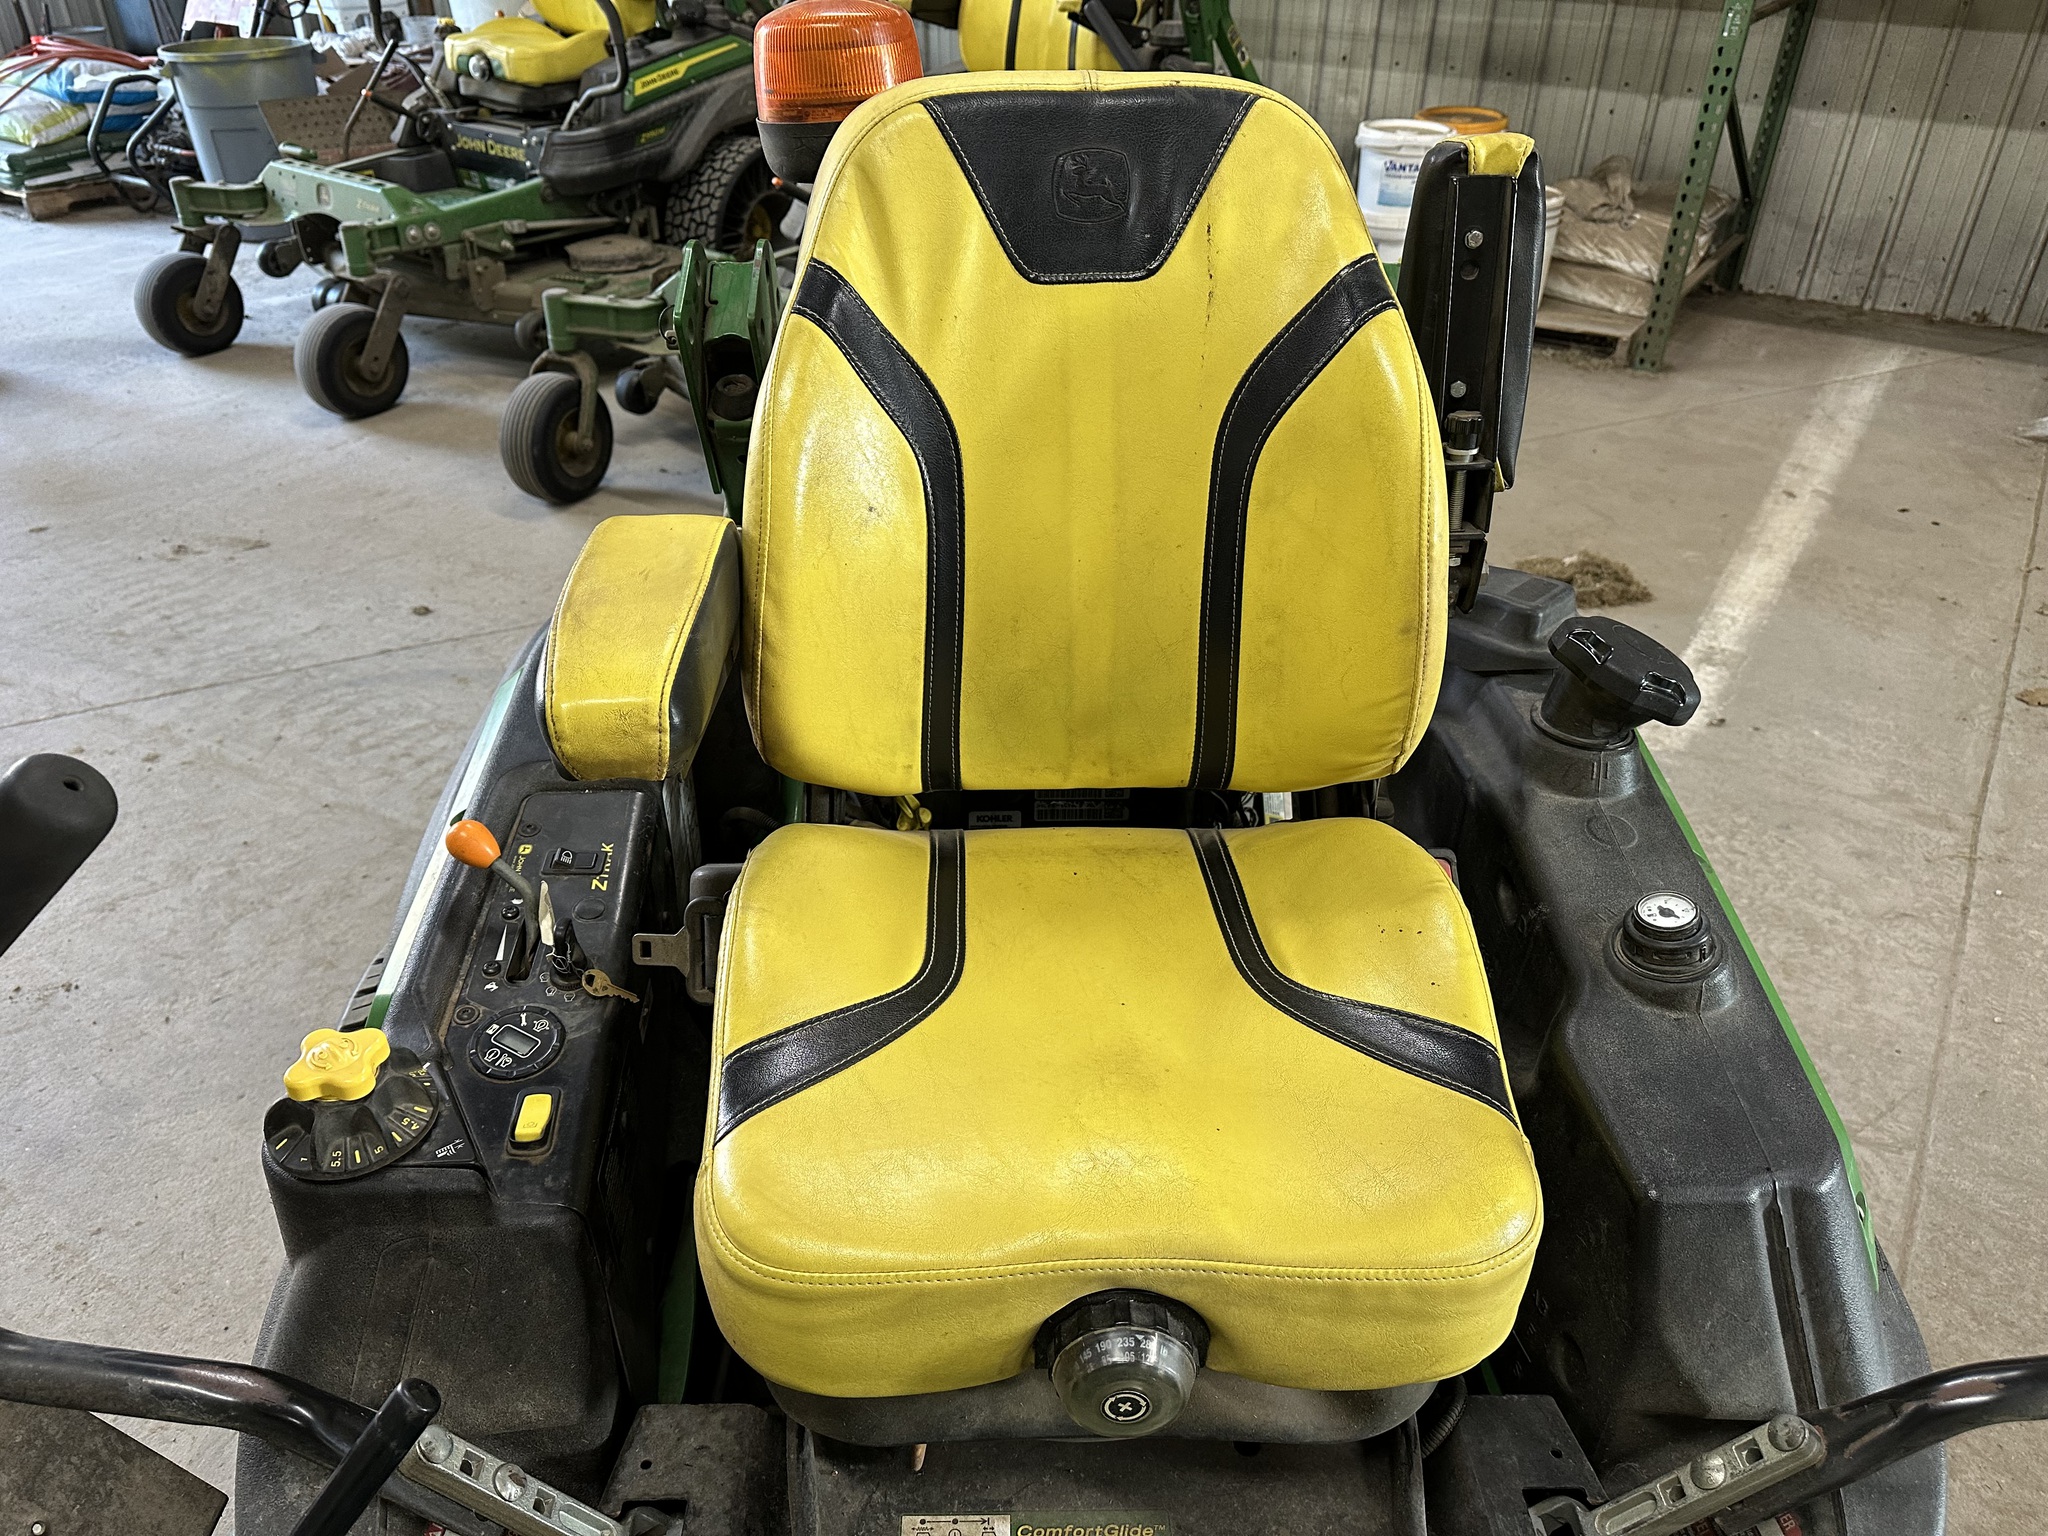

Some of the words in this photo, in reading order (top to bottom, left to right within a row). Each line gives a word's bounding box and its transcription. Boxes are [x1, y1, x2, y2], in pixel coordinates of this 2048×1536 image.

[457, 134, 486, 153] JOHN
[487, 139, 527, 162] DEERE
[976, 814, 1013, 823] KOHLER
[374, 1145, 384, 1154] 5
[331, 1150, 342, 1168] 5.5
[1095, 1339, 1112, 1353] 190
[1117, 1336, 1135, 1348] 235
[1139, 1338, 1155, 1350] 28
